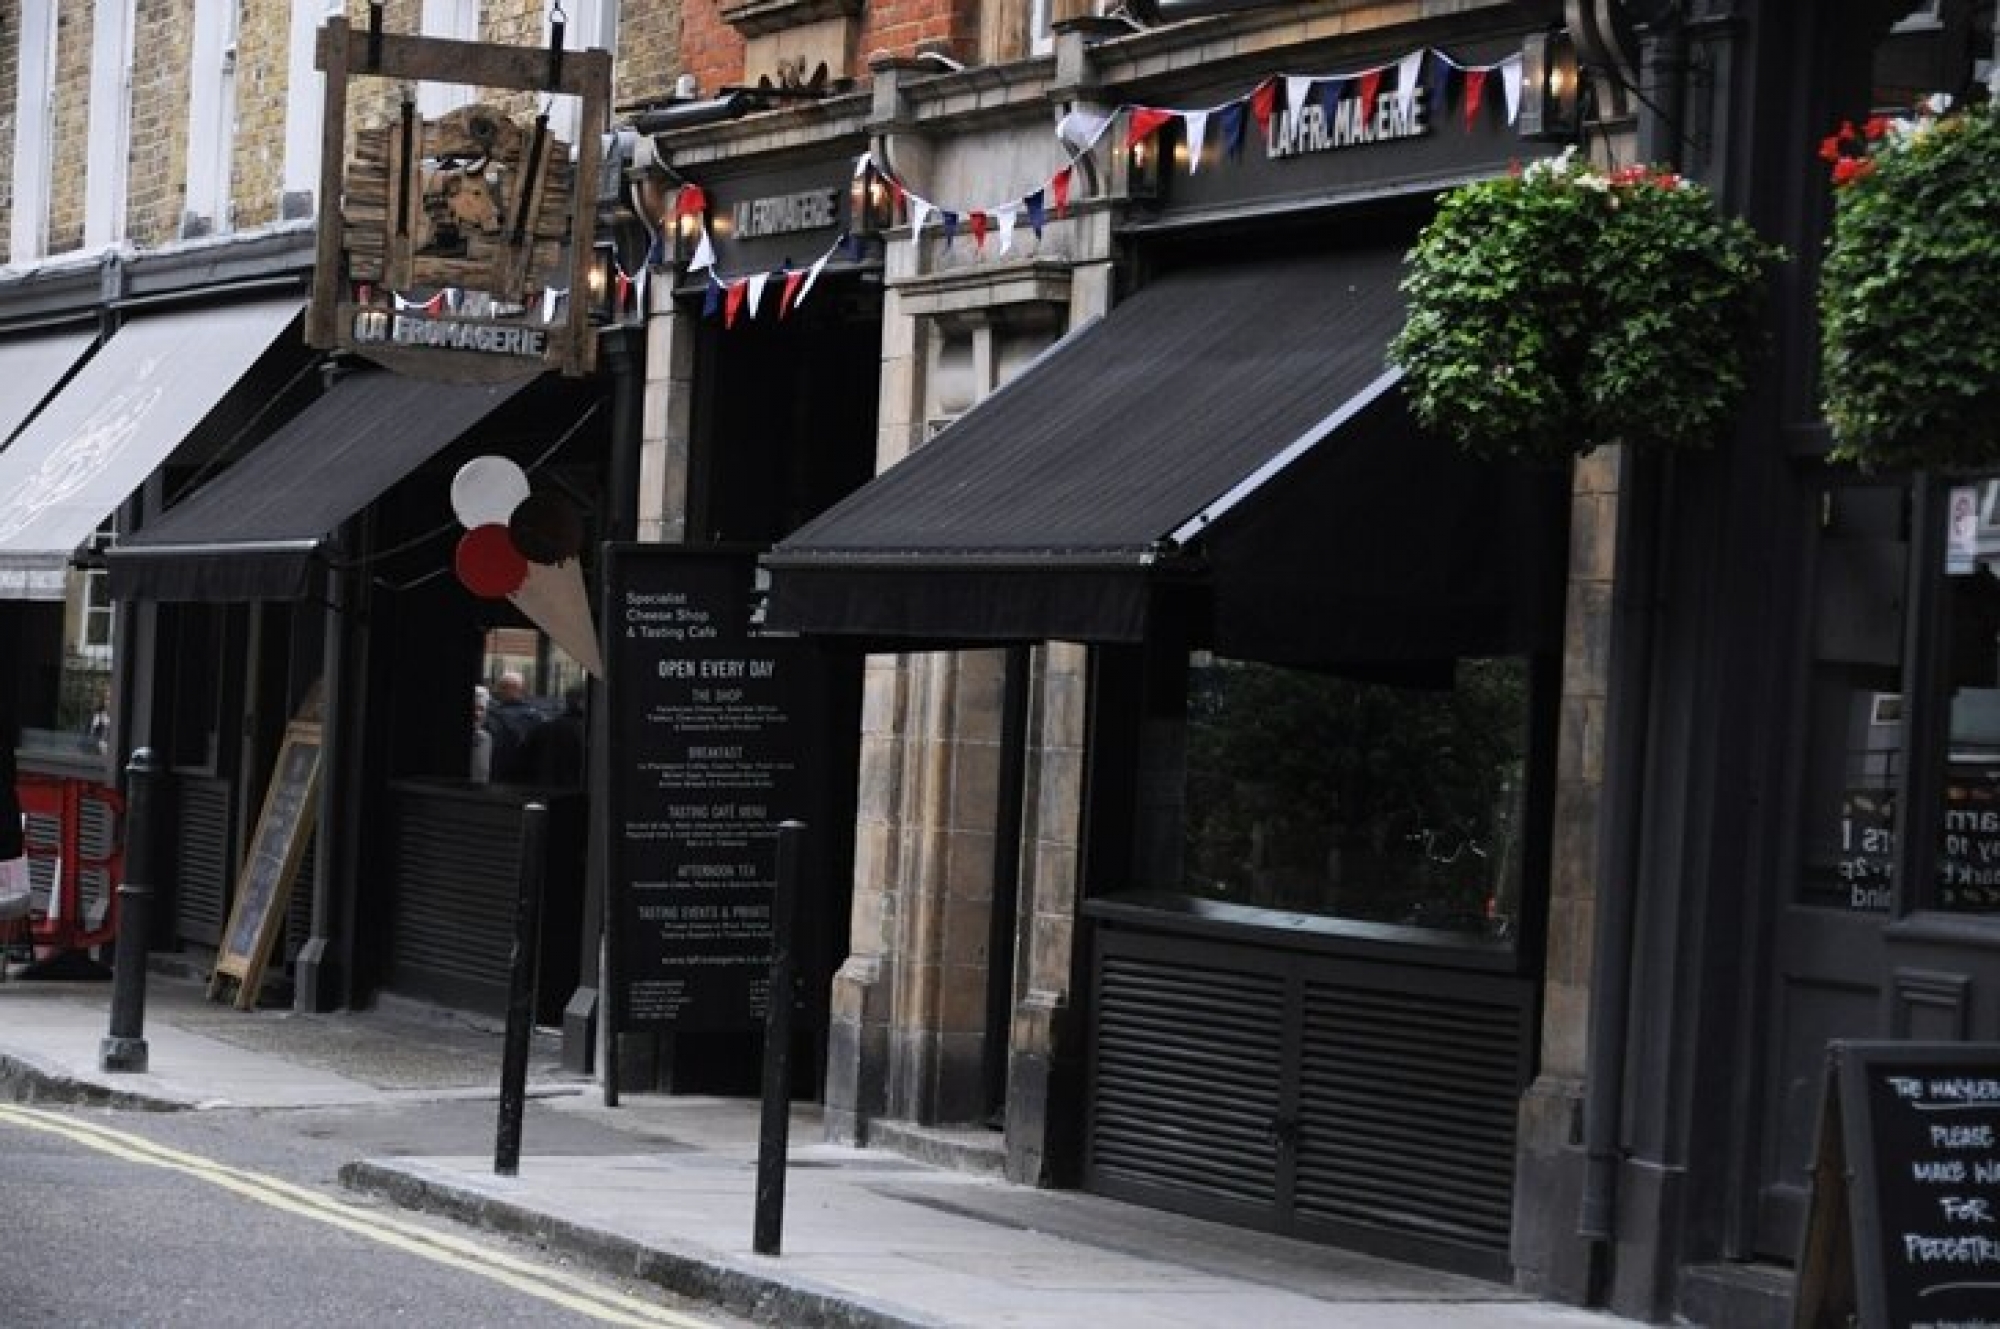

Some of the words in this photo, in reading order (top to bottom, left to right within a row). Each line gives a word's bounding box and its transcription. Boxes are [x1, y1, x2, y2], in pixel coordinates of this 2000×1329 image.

[355, 312, 389, 342] LA
[393, 315, 546, 355] FROMAGERIE
[626, 592, 687, 606] Specialist
[626, 609, 674, 621] Cheese
[676, 608, 710, 624] Shop
[640, 626, 685, 641] Tasting
[658, 660, 696, 678] OPEN
[700, 660, 745, 678] EVERY
[750, 660, 775, 678] DAY
[1938, 1196, 1995, 1222] FOR
